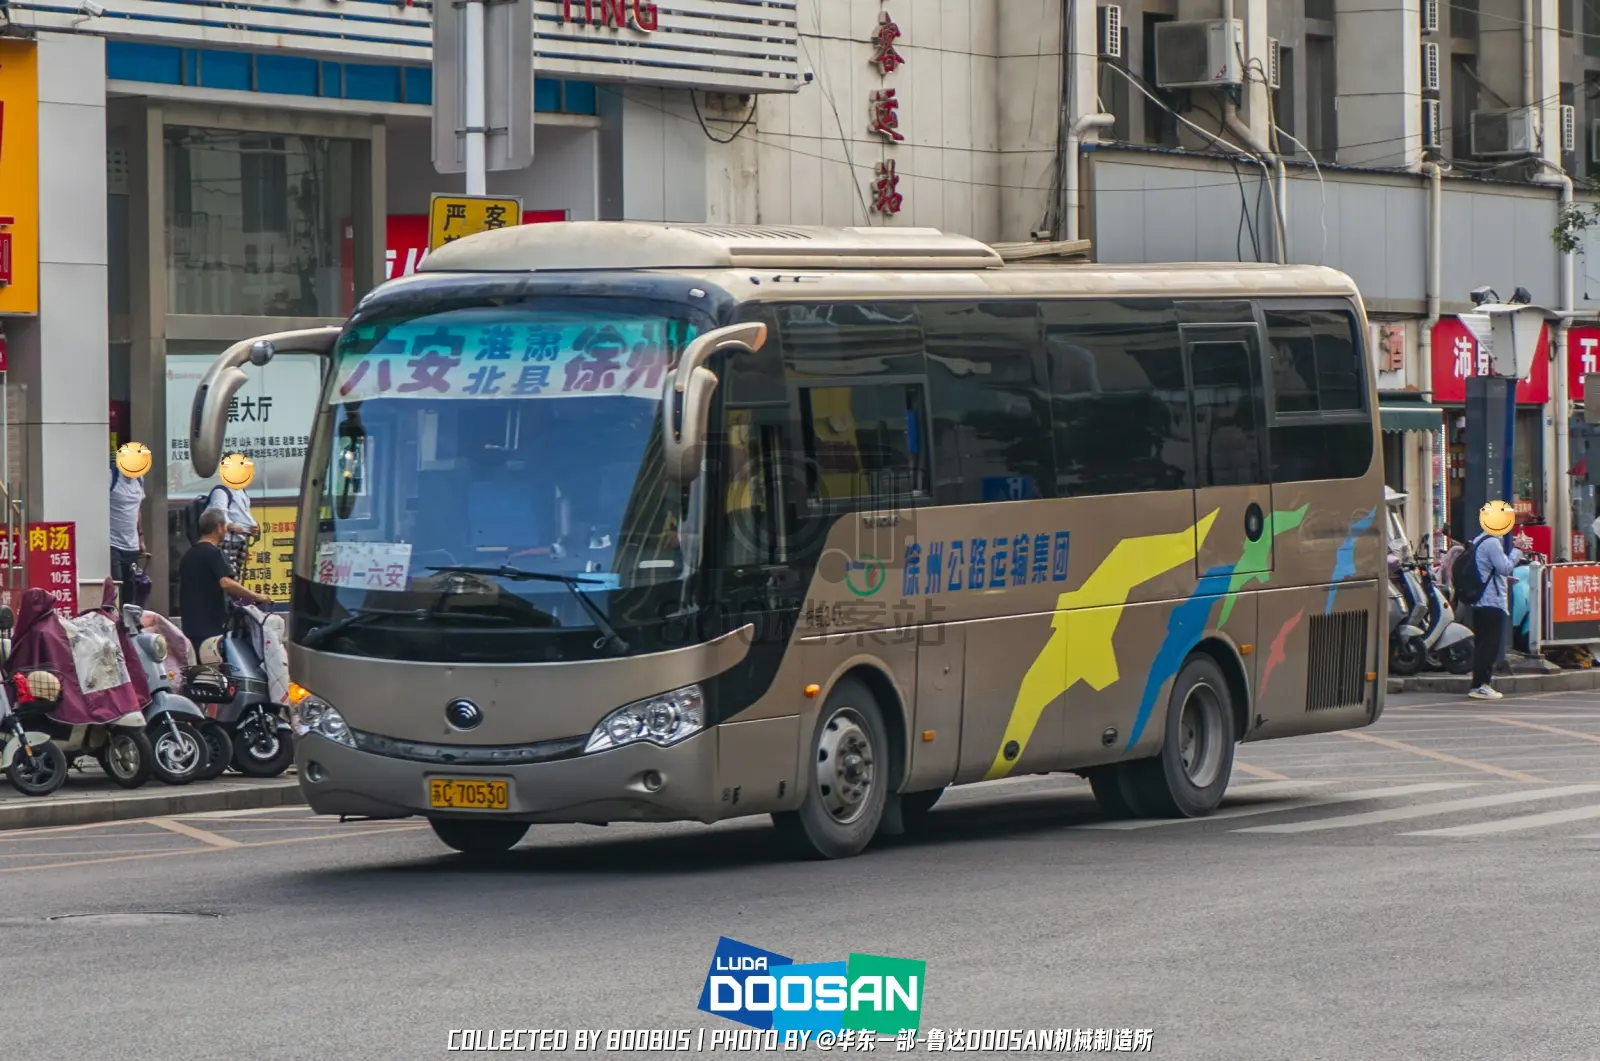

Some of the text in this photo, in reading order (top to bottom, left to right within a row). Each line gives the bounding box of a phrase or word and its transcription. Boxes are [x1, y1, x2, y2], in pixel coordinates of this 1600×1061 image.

[868, 10, 905, 217] 客运站
[50, 552, 71, 566] 15元
[50, 570, 72, 584] 10元
[902, 530, 1071, 596] 徐州公路运输集团
